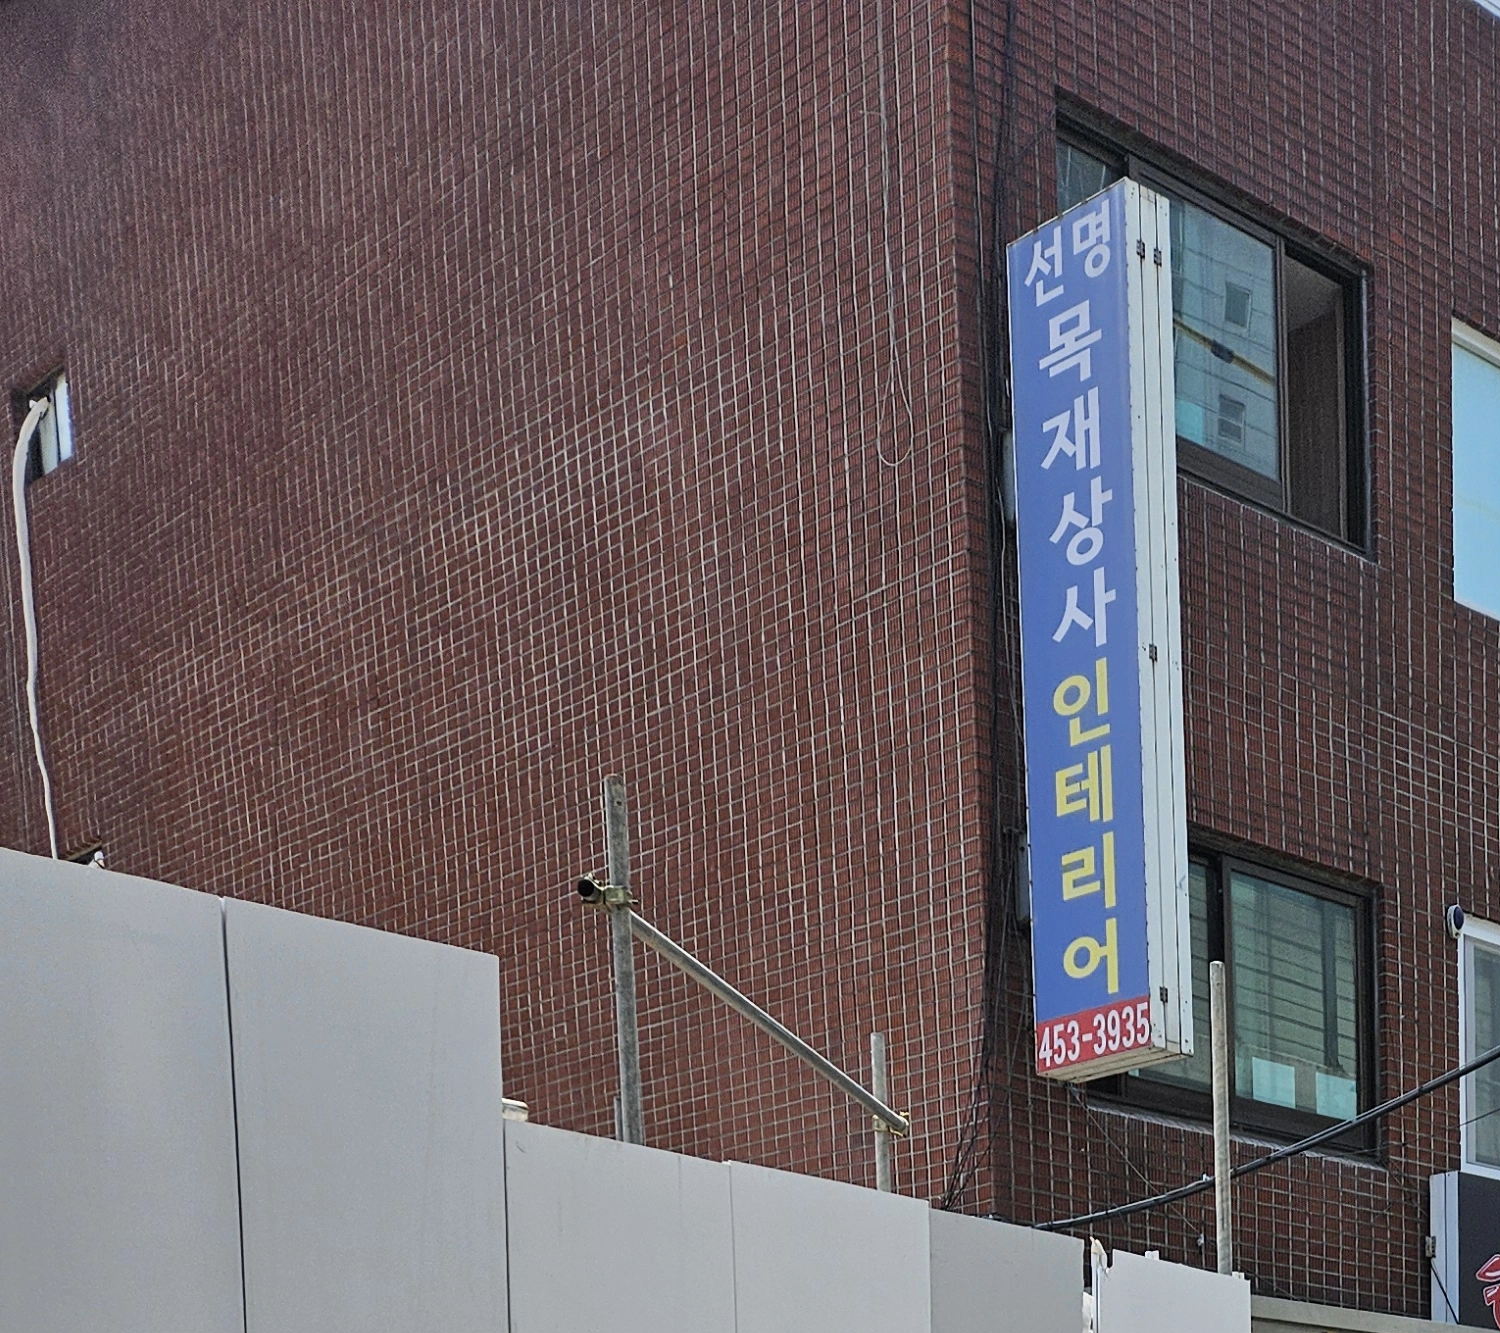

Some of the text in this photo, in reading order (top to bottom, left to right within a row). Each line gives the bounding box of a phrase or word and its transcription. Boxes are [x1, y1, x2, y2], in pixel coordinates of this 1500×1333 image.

[1024, 199, 1112, 307] 선명
[1053, 657, 1119, 995] 인테리어
[1038, 1002, 1150, 1068] 453-3935
